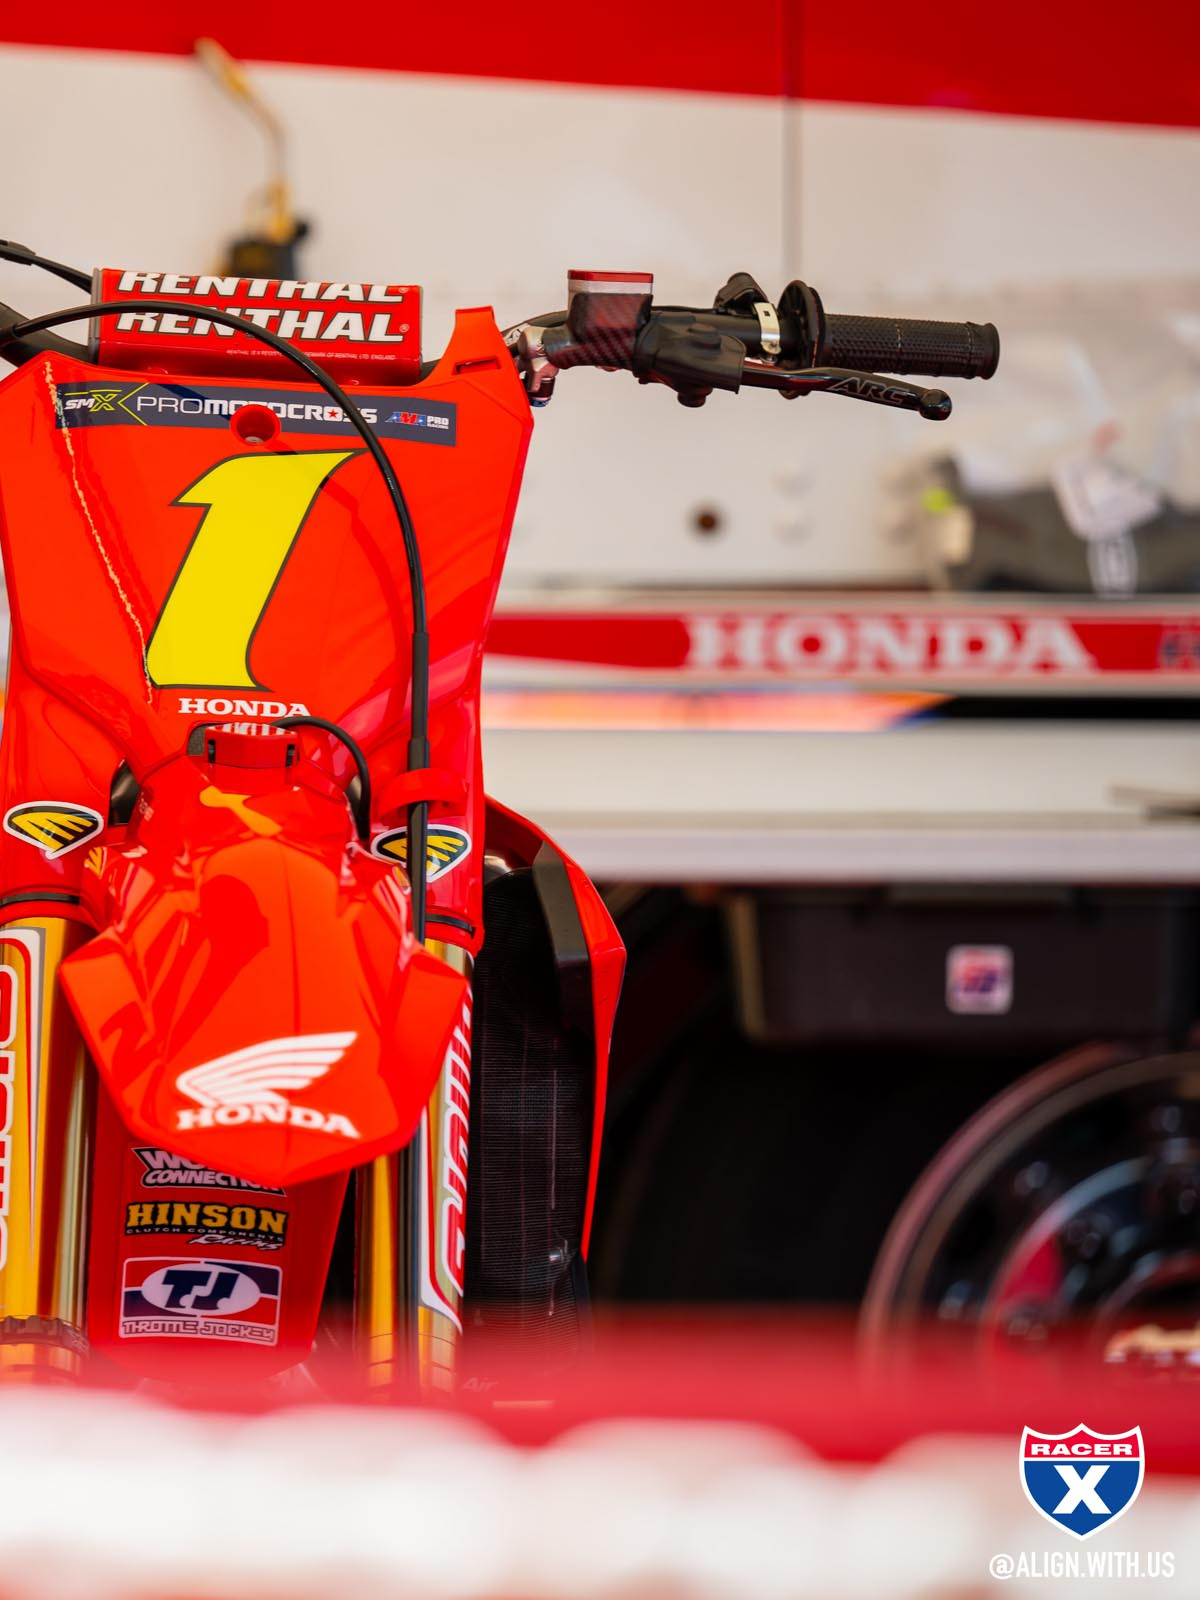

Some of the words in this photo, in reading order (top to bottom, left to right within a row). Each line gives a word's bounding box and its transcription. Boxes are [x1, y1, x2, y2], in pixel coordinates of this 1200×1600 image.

[829, 376, 911, 404] ARC
[143, 448, 365, 693] 1
[692, 614, 1098, 678] HONDA
[178, 697, 312, 718] HONDA
[176, 1102, 362, 1139] HONDA
[126, 1202, 288, 1235] HINSON
[162, 1269, 241, 1311] TJ
[122, 1320, 200, 1336] THROTTLE
[200, 1320, 276, 1344] JOCKEY
